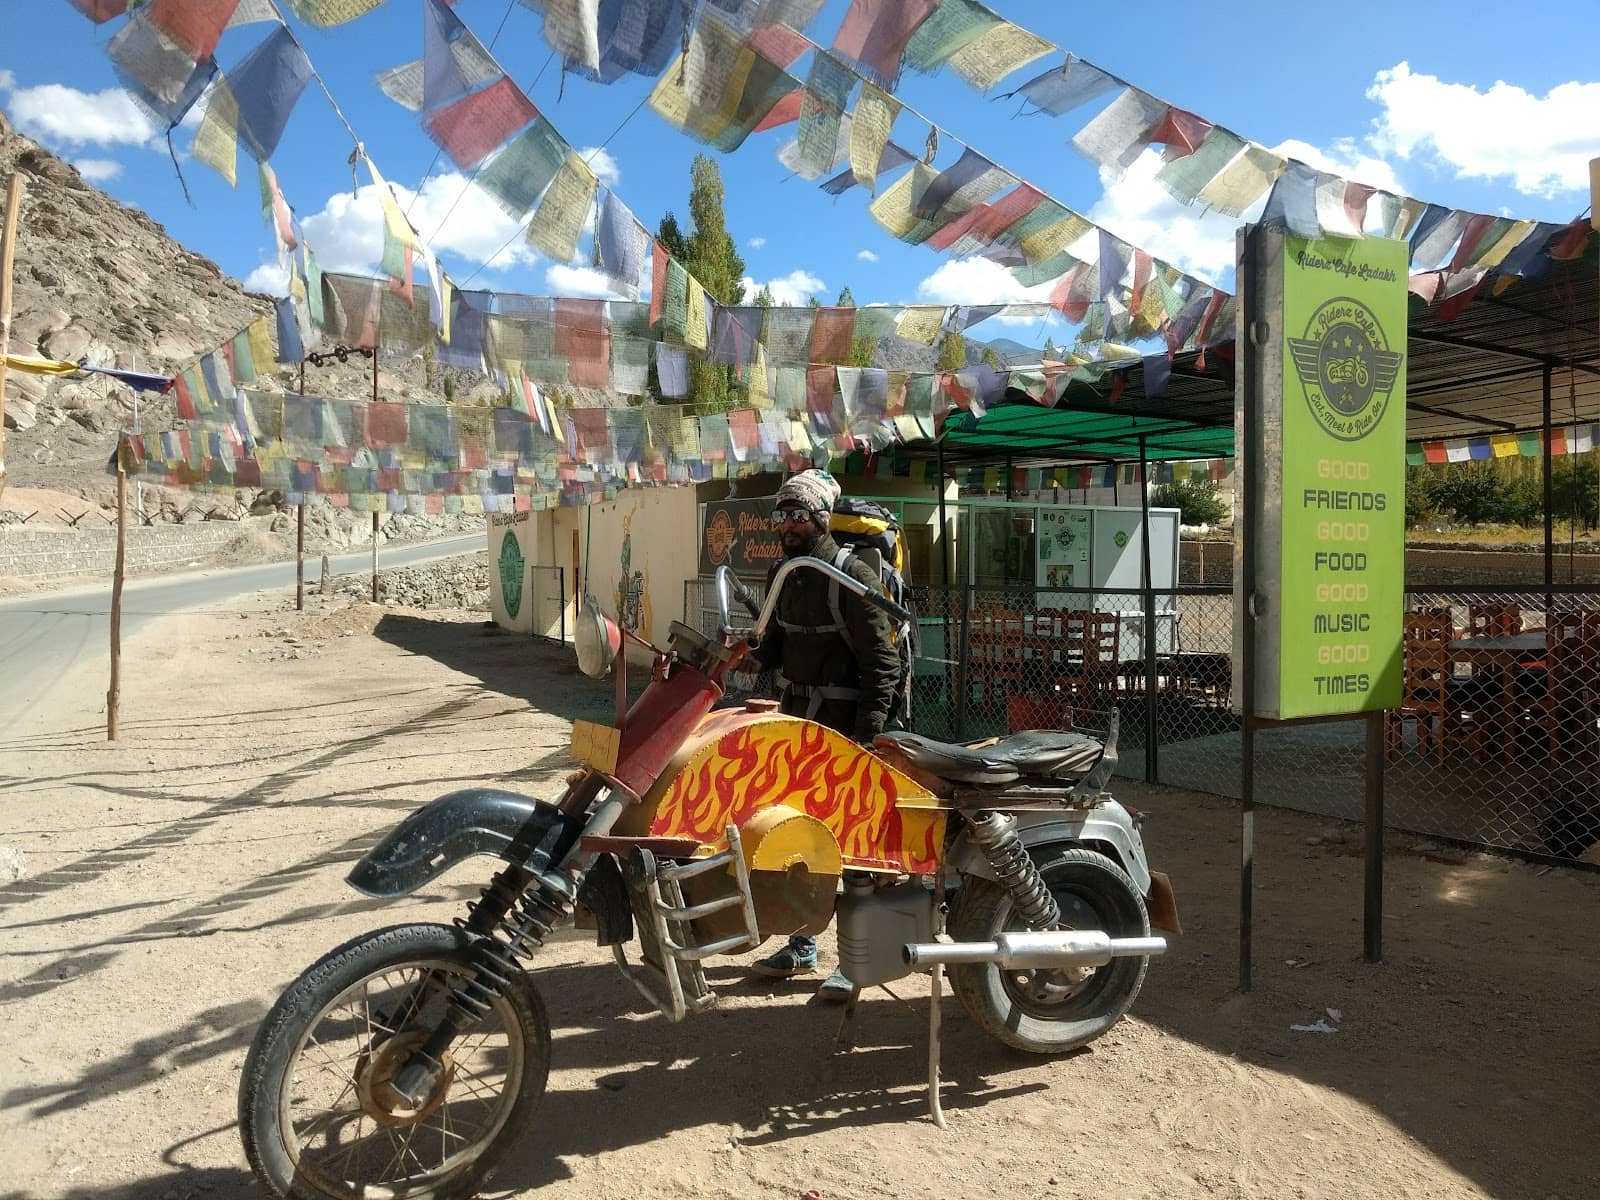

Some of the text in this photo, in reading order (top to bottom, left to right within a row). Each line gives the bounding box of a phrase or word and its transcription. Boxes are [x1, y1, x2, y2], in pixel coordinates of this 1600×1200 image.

[1333, 258, 1357, 278] Cafe
[1358, 263, 1396, 282] Ladakh
[1354, 308, 1376, 338] Cafe
[1324, 411, 1345, 433] Meet
[1318, 458, 1370, 480] GOOD
[1303, 489, 1386, 511] FRIENDS
[1317, 521, 1370, 541] GOOD
[1315, 552, 1367, 571] FOOD
[1316, 583, 1368, 602] GOOD
[1314, 613, 1370, 633] MUSIC
[1318, 644, 1370, 664] GOOD
[1313, 674, 1370, 695] TIMES
